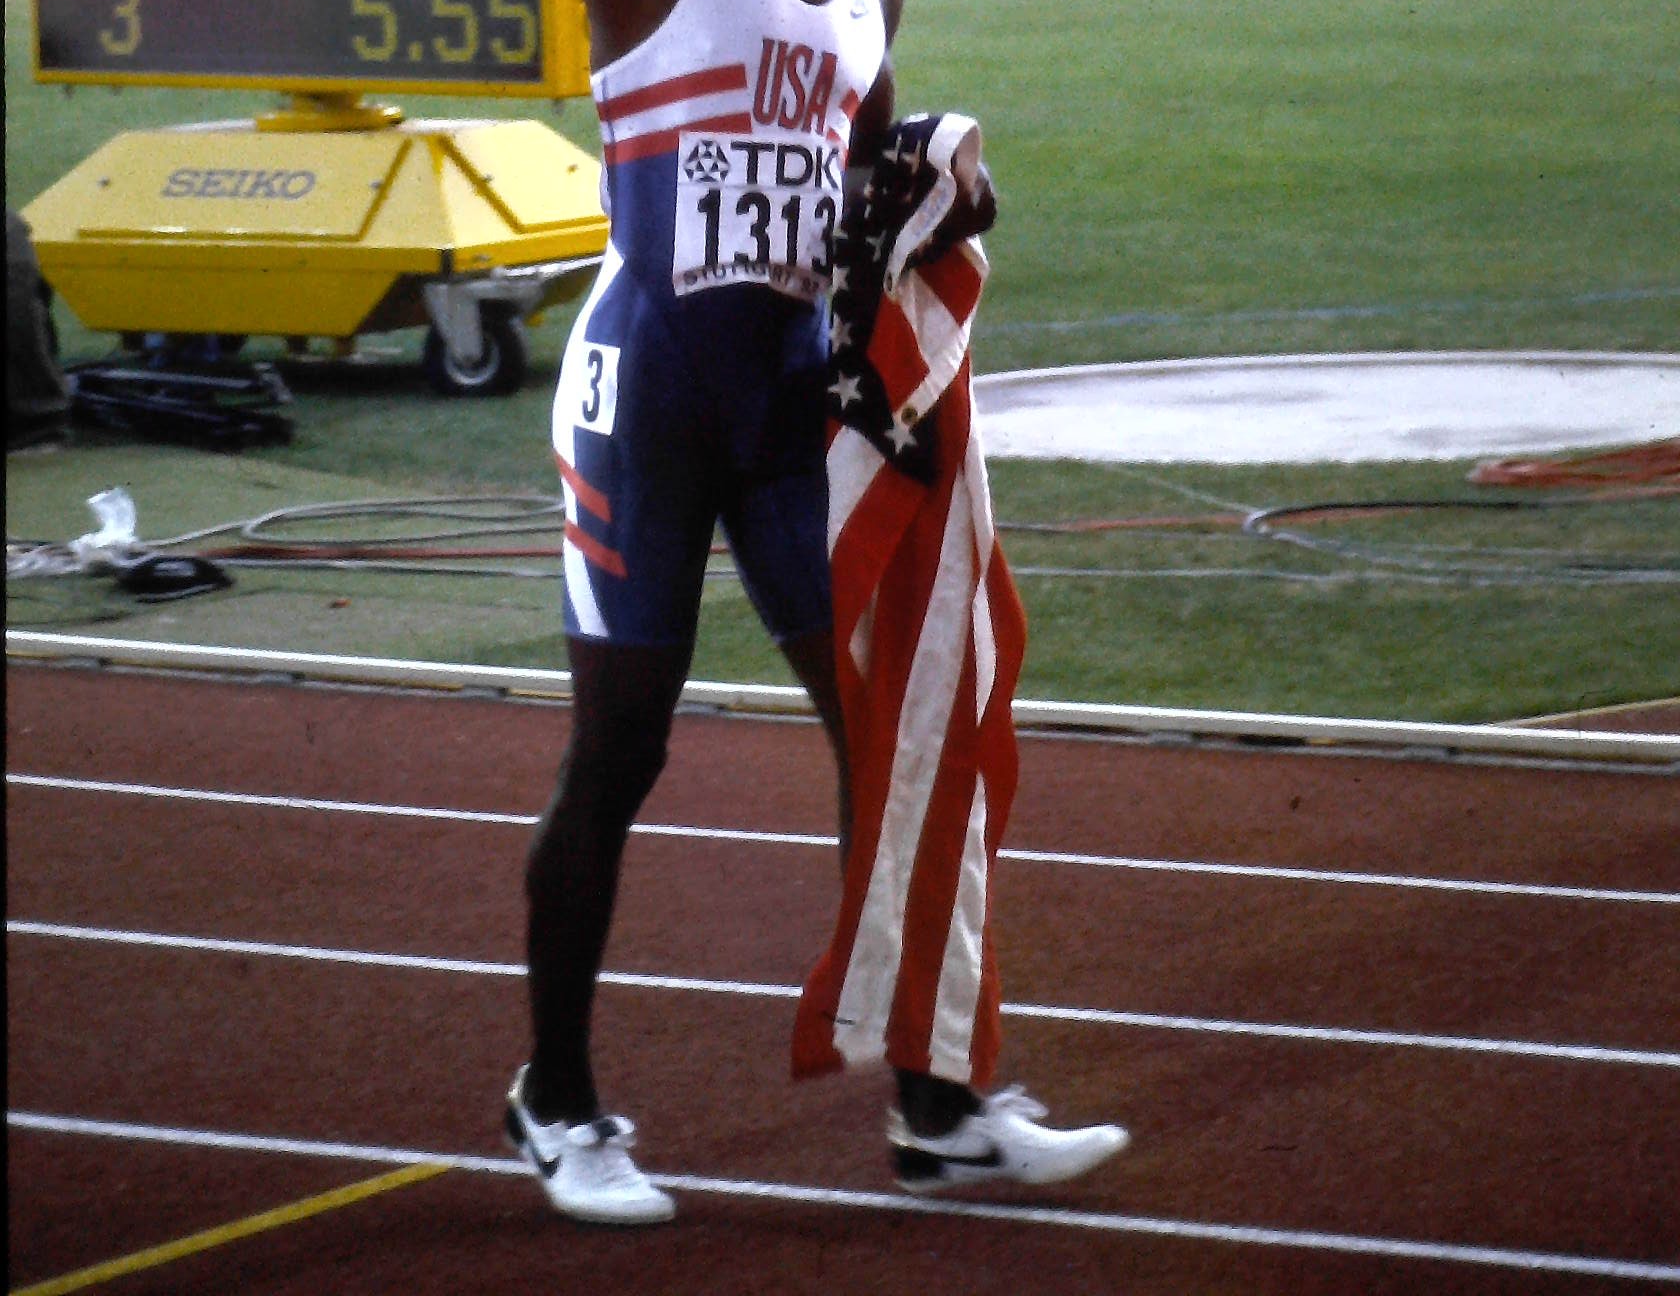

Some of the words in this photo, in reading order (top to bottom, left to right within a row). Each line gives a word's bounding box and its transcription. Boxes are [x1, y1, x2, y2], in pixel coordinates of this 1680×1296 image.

[753, 38, 838, 135] USA
[161, 168, 316, 200] SEIKO
[730, 141, 839, 191] TDK
[697, 188, 836, 277] 1313
[582, 349, 603, 423] 3
